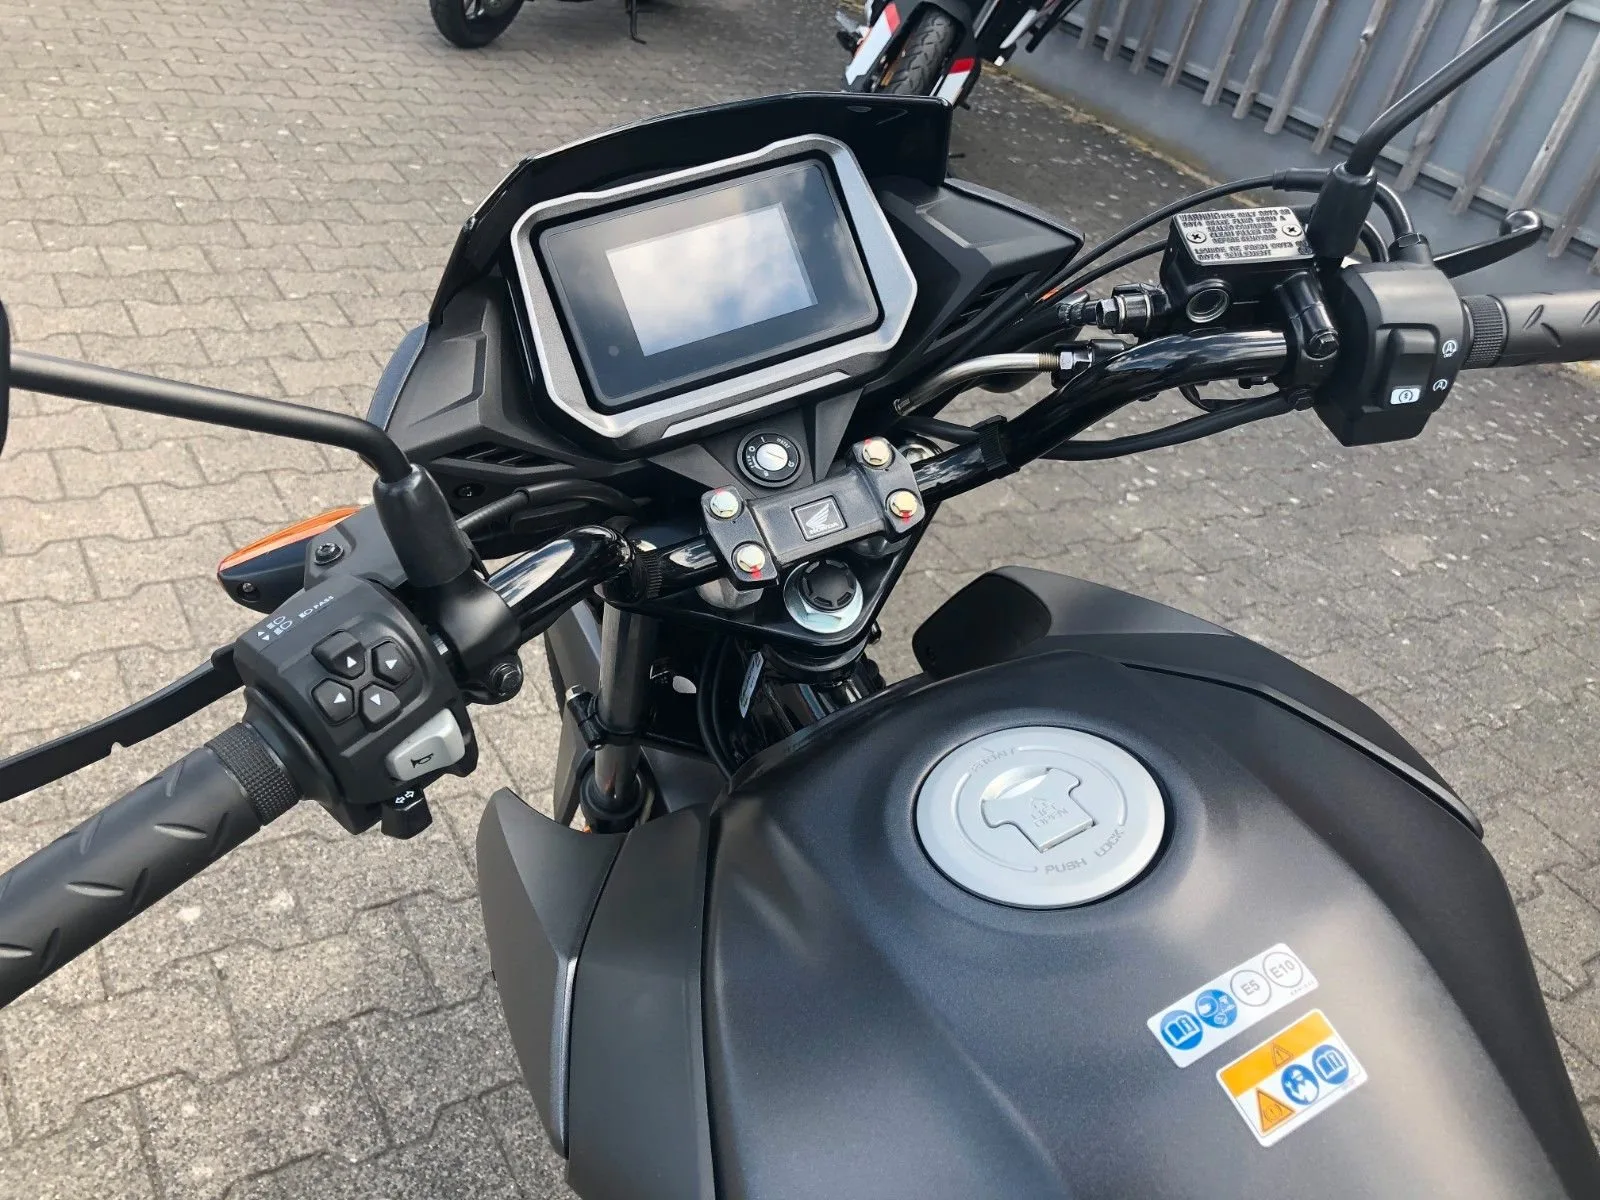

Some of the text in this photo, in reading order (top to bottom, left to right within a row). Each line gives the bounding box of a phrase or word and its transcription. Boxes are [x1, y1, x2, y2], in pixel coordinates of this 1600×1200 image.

[1044, 829, 1124, 874] PUSH LOCK
[1240, 960, 1295, 996] E5 E10
